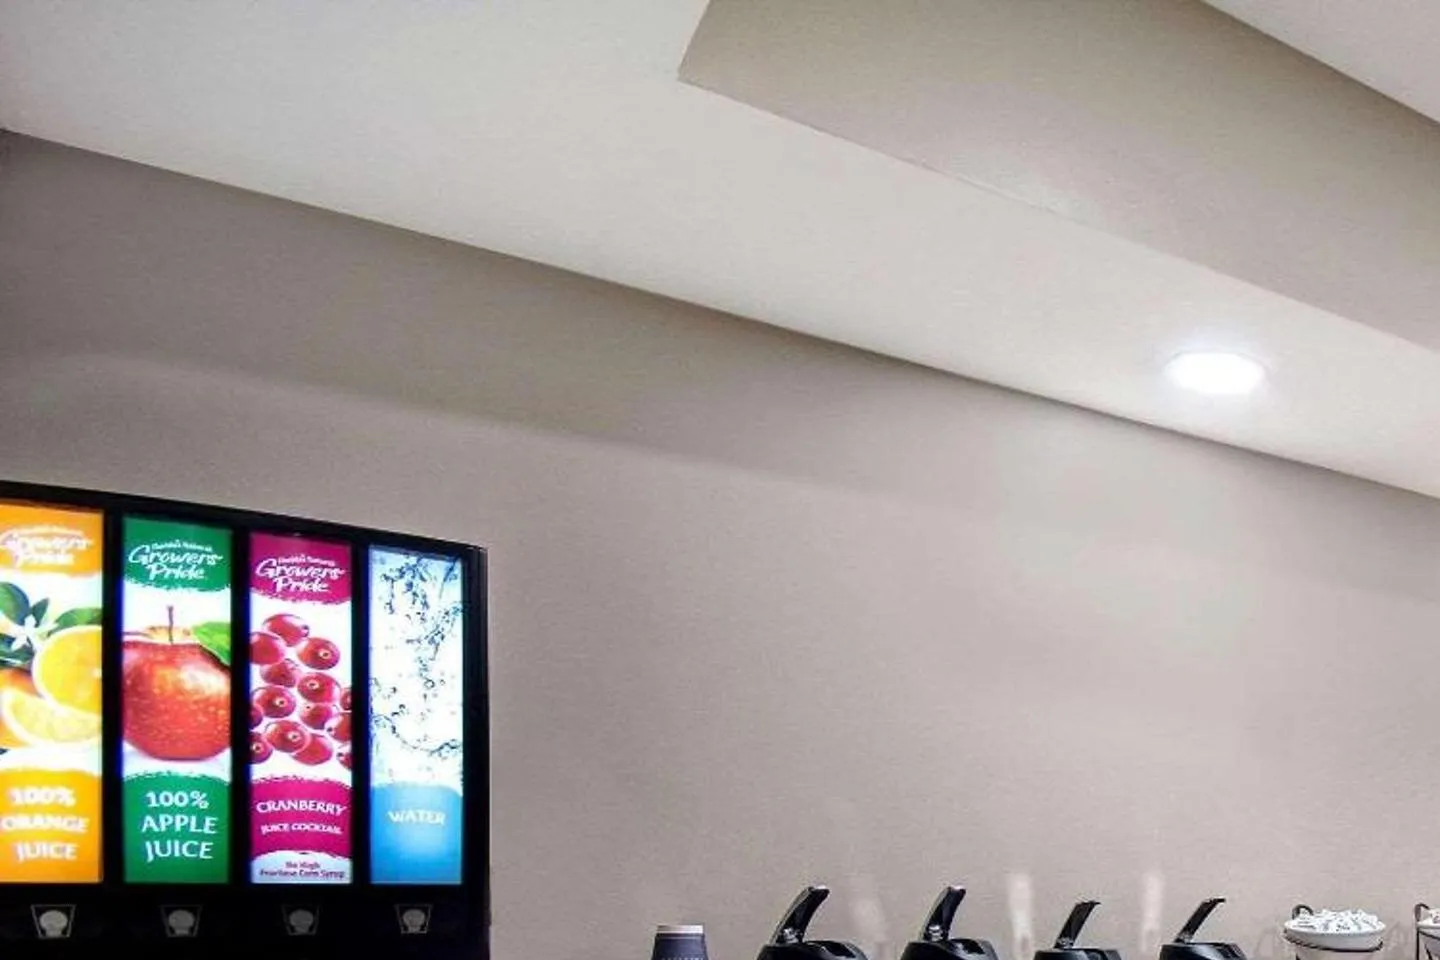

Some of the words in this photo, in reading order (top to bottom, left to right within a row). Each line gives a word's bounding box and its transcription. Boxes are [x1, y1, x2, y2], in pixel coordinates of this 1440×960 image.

[128, 544, 223, 566] Growers
[145, 562, 205, 580] Pride
[255, 558, 345, 580] Growers
[273, 576, 329, 593] Pride
[9, 785, 76, 808] 100%
[145, 790, 210, 809] 100%
[256, 799, 348, 816] CRANBERRY
[387, 809, 446, 825] WATER
[0, 813, 90, 834] ORANGE
[141, 813, 218, 834] APPLE
[260, 823, 289, 836] JUICE
[291, 822, 343, 835] COCKTAIL
[16, 841, 78, 863] JUICE
[145, 839, 214, 863] JUICE
